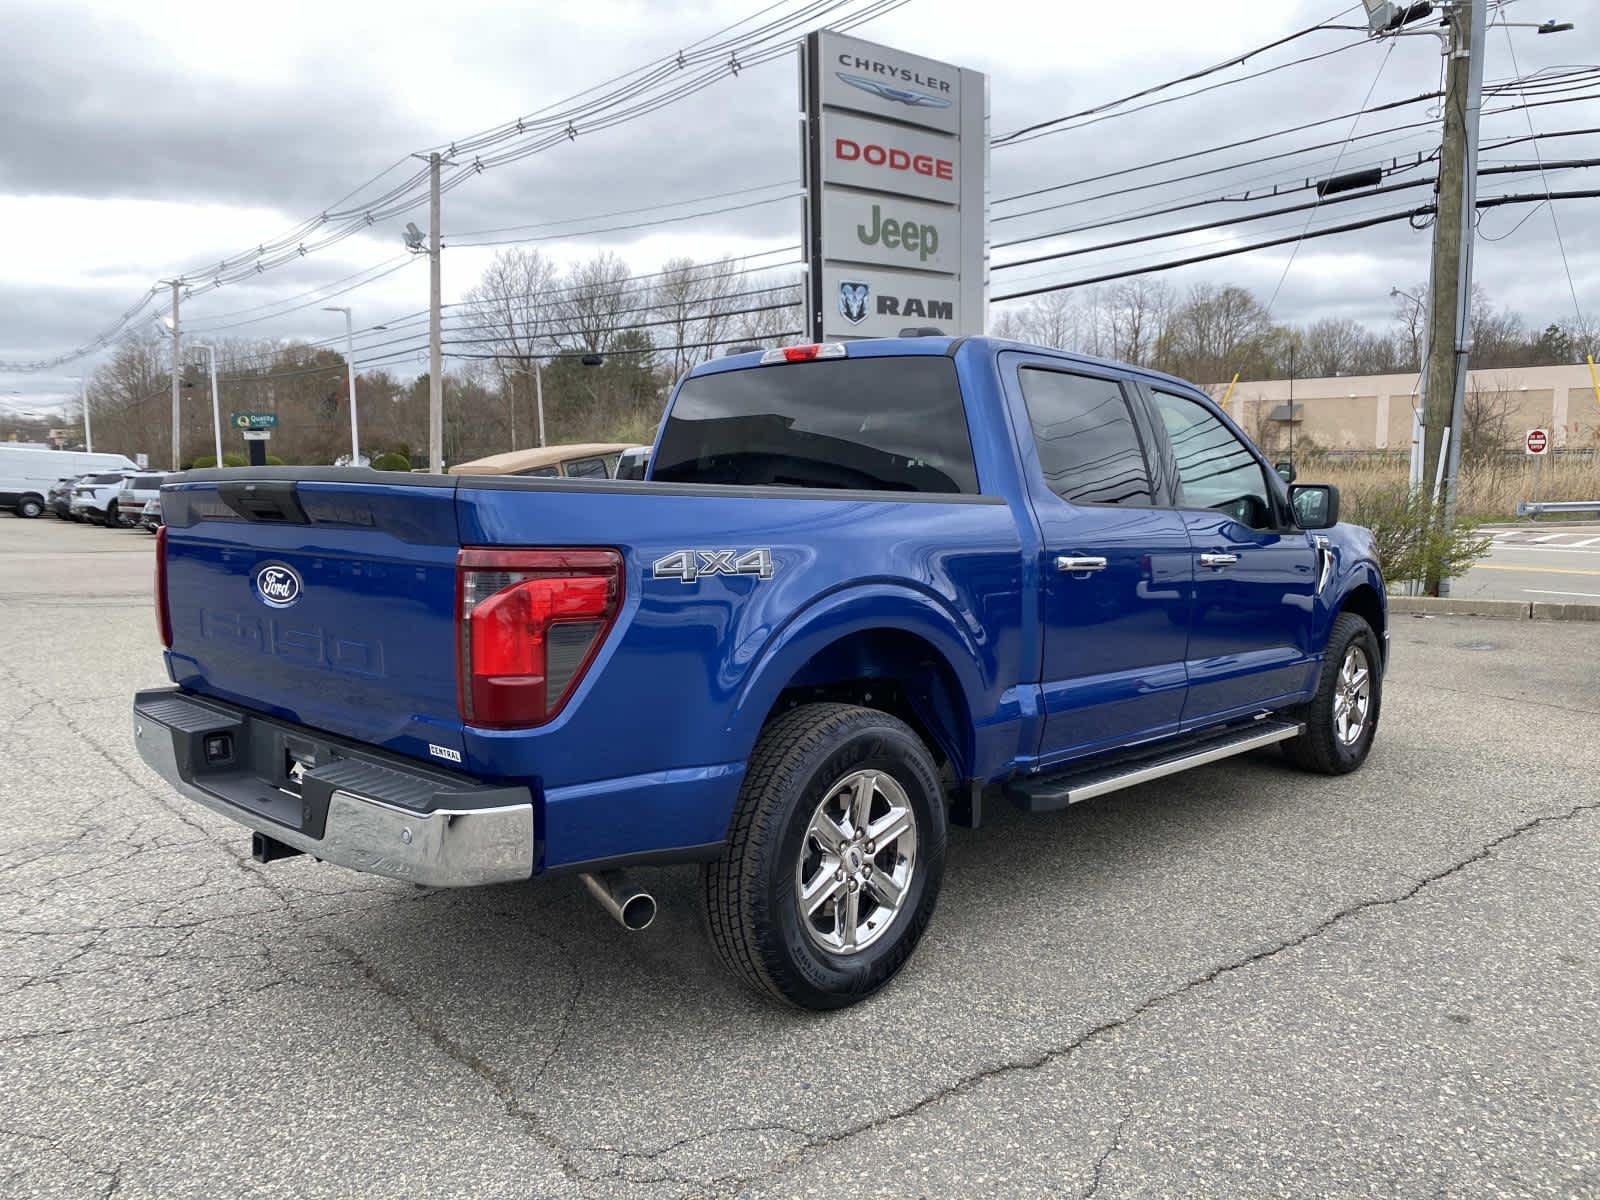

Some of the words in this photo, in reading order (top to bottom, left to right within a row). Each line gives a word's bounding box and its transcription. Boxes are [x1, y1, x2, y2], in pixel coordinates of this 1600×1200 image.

[839, 54, 951, 92] CHRYSLER
[835, 139, 953, 180] DODGE
[857, 204, 938, 261] Jeep
[876, 295, 953, 320] RAM
[263, 570, 289, 597] Ford
[430, 745, 460, 761] CENTRAL
